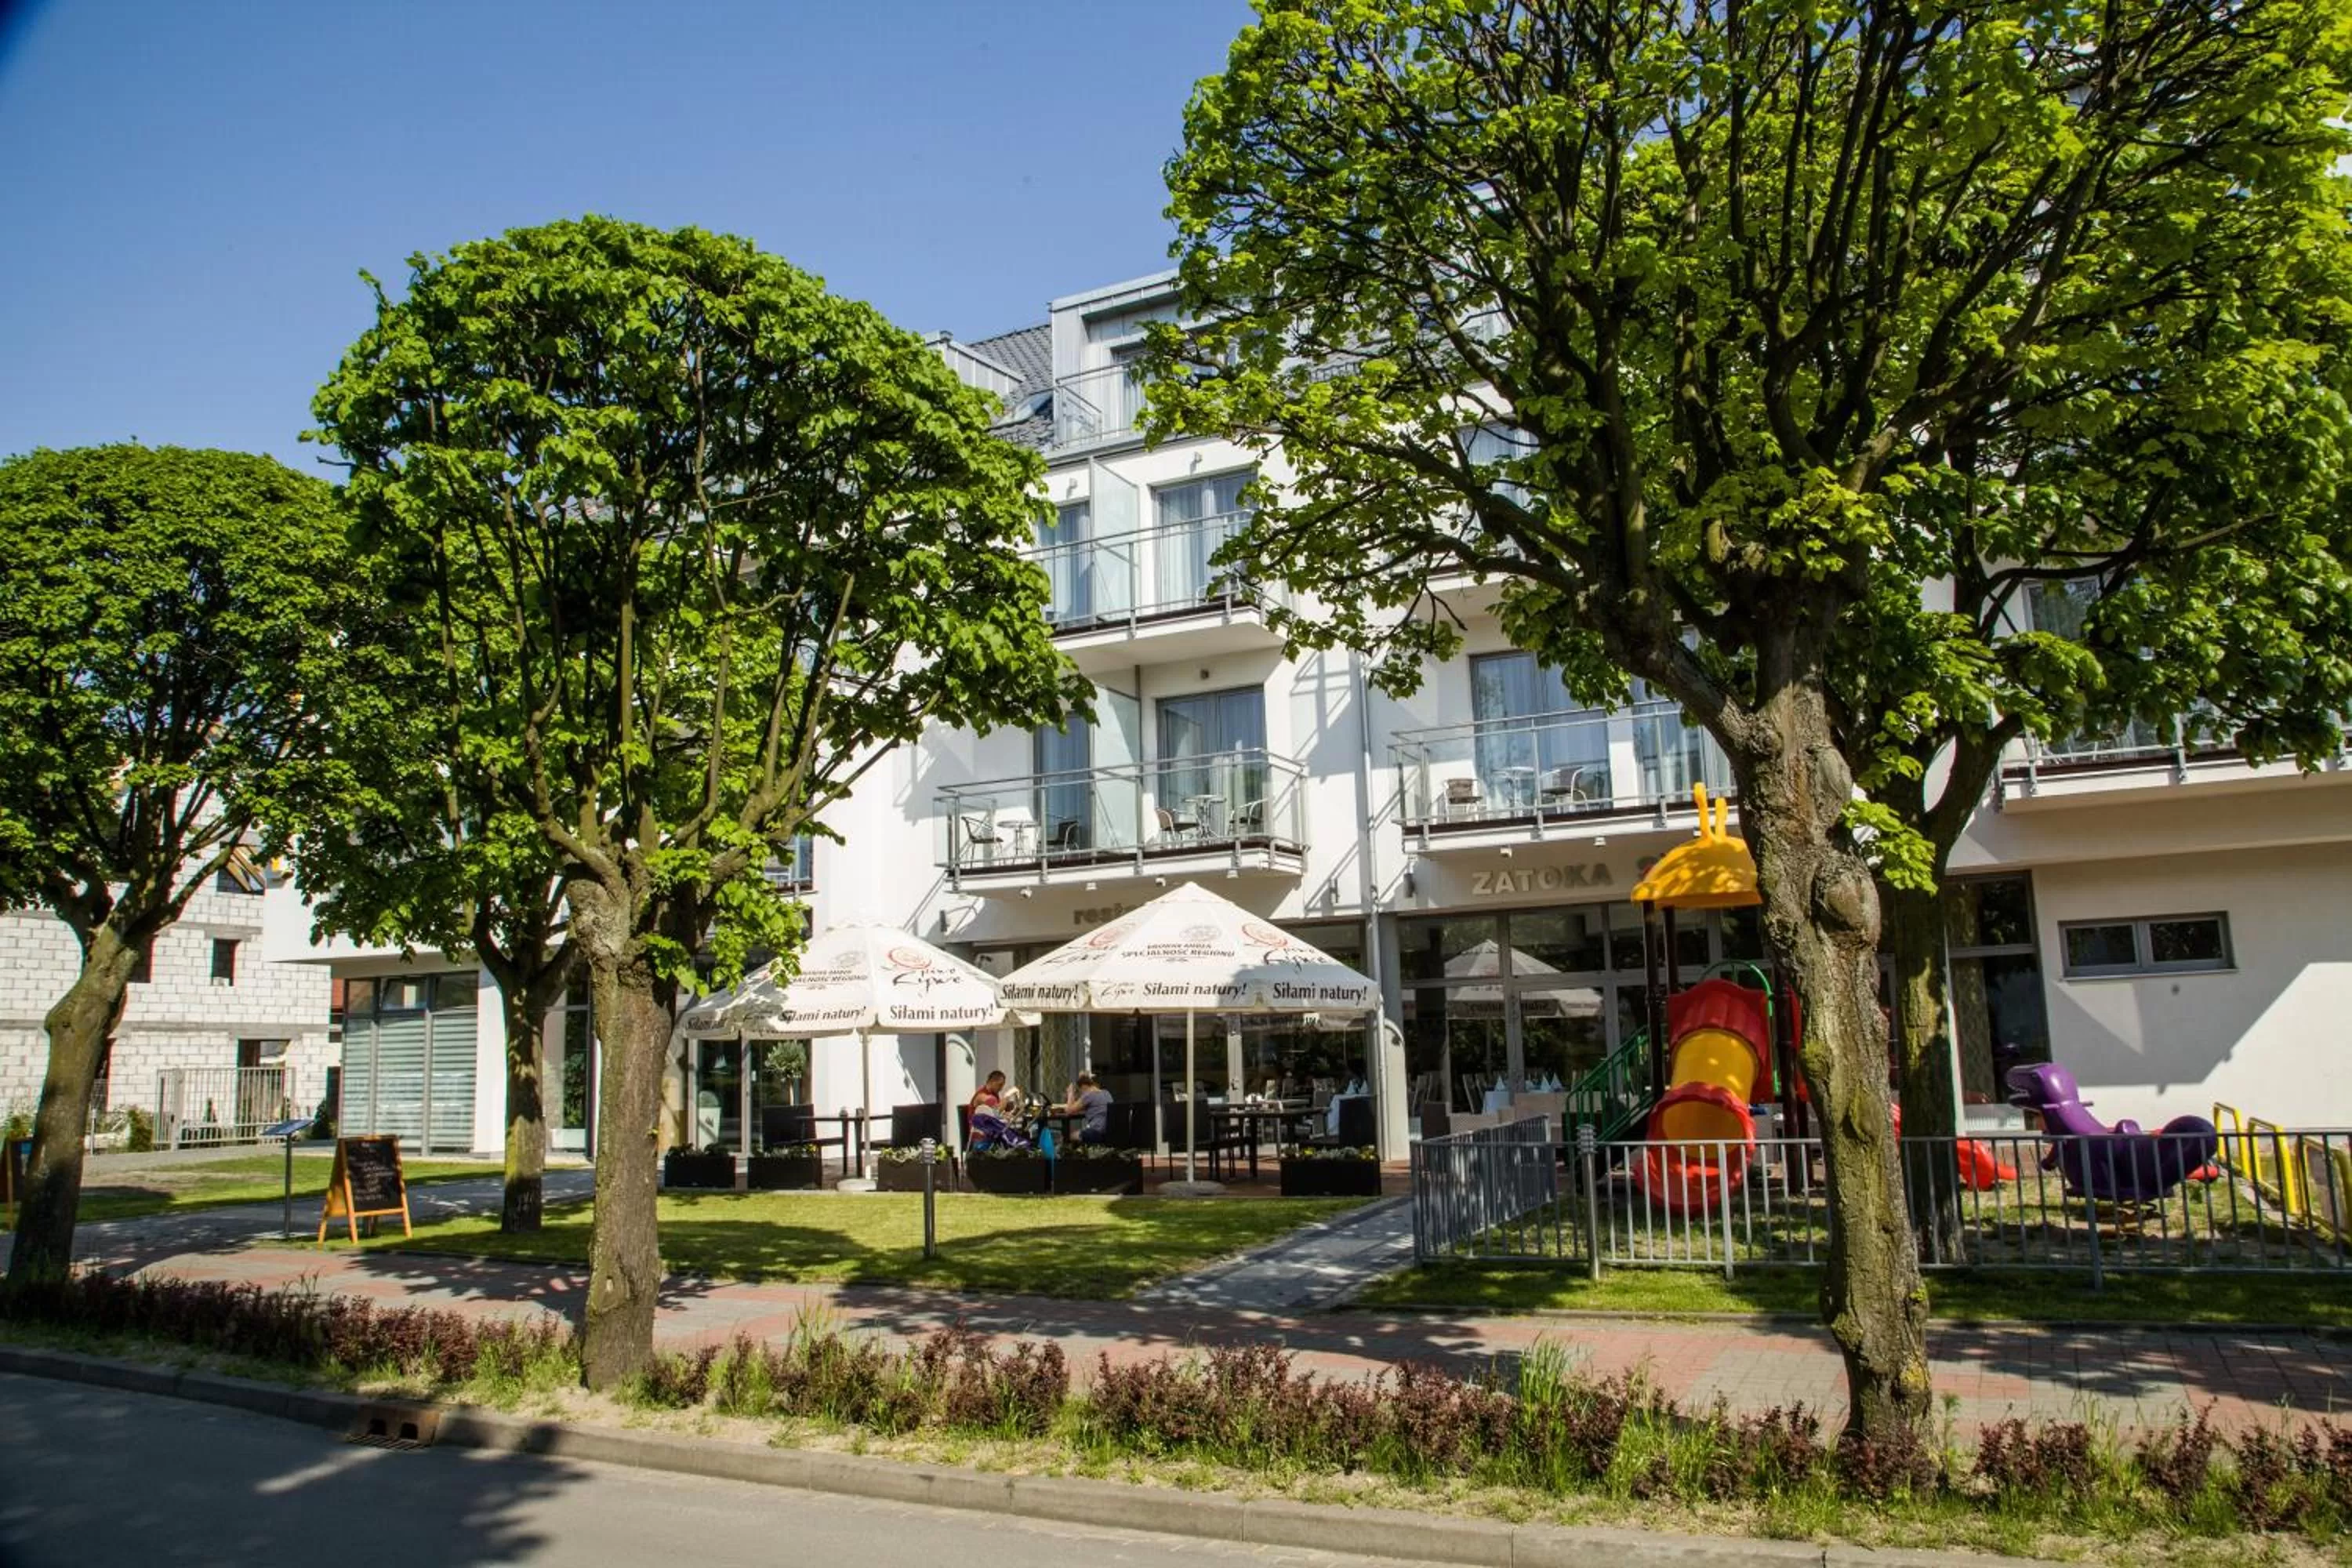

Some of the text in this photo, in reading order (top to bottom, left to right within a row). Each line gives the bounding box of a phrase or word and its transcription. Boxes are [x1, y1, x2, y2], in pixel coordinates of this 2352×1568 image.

[1472, 863, 1614, 895] ZATOKA
[1001, 982, 1079, 1004] Siłami natury!
[1142, 982, 1247, 1000] Siłami natury!
[1272, 982, 1368, 1005] Siłami natury!
[890, 1003, 994, 1020] Siłami natury!
